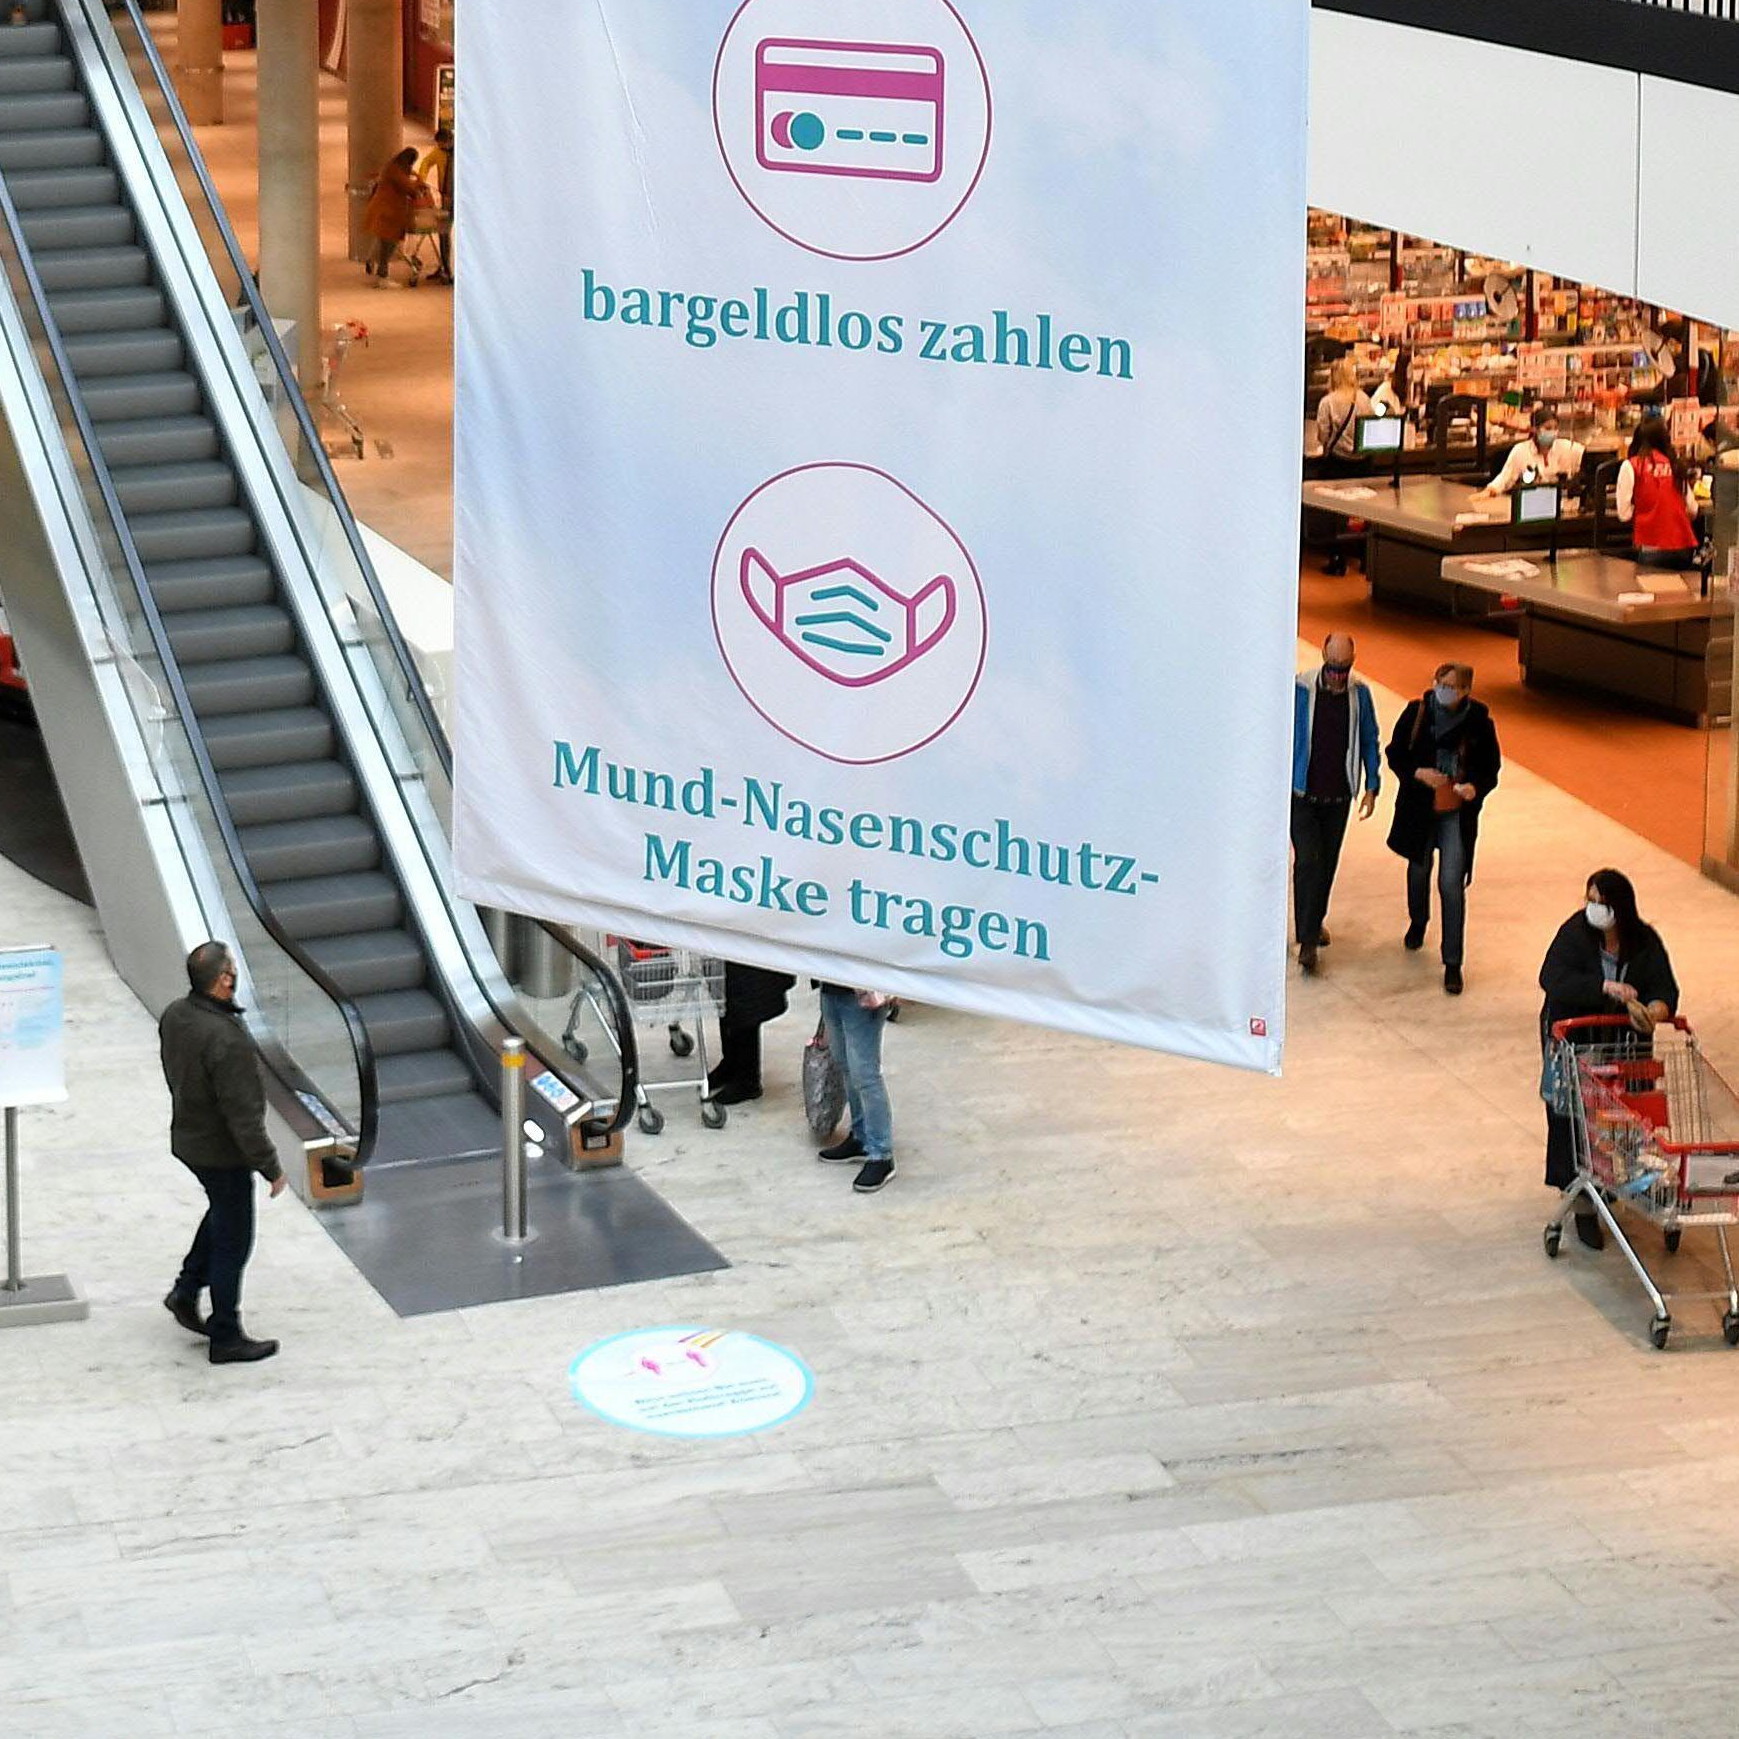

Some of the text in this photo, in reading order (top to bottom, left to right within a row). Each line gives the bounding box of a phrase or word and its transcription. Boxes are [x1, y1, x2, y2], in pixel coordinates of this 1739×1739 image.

[581, 268, 1133, 379] bargeldlos zahlen
[553, 741, 1159, 895] Mund-Nasenschutz-
[644, 834, 1051, 961] Maske tragen
